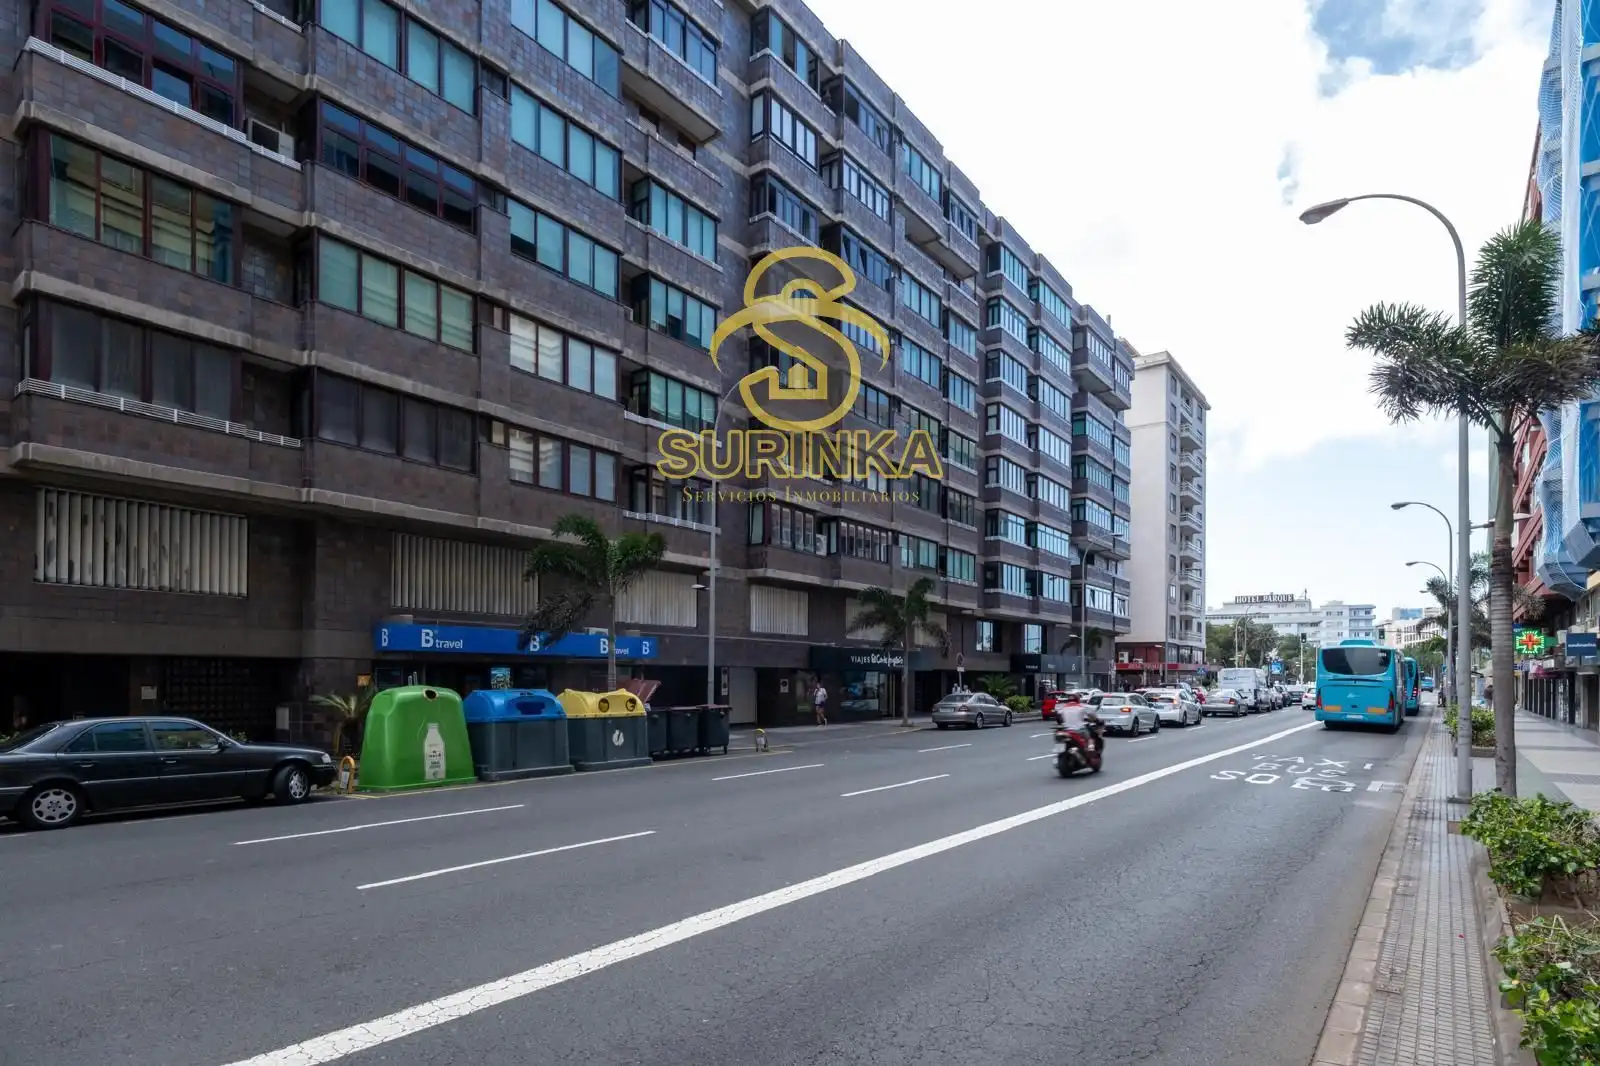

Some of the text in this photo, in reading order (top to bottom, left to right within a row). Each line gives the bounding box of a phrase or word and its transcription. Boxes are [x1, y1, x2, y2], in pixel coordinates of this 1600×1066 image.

[1235, 593, 1294, 604] HOTEL PARQUE
[381, 628, 389, 647] B
[421, 628, 463, 649] B travel
[530, 635, 540, 651] B
[600, 638, 609, 654] B
[642, 641, 650, 655] B
[851, 655, 870, 664] VIAJES
[1249, 762, 1348, 778] BUS
